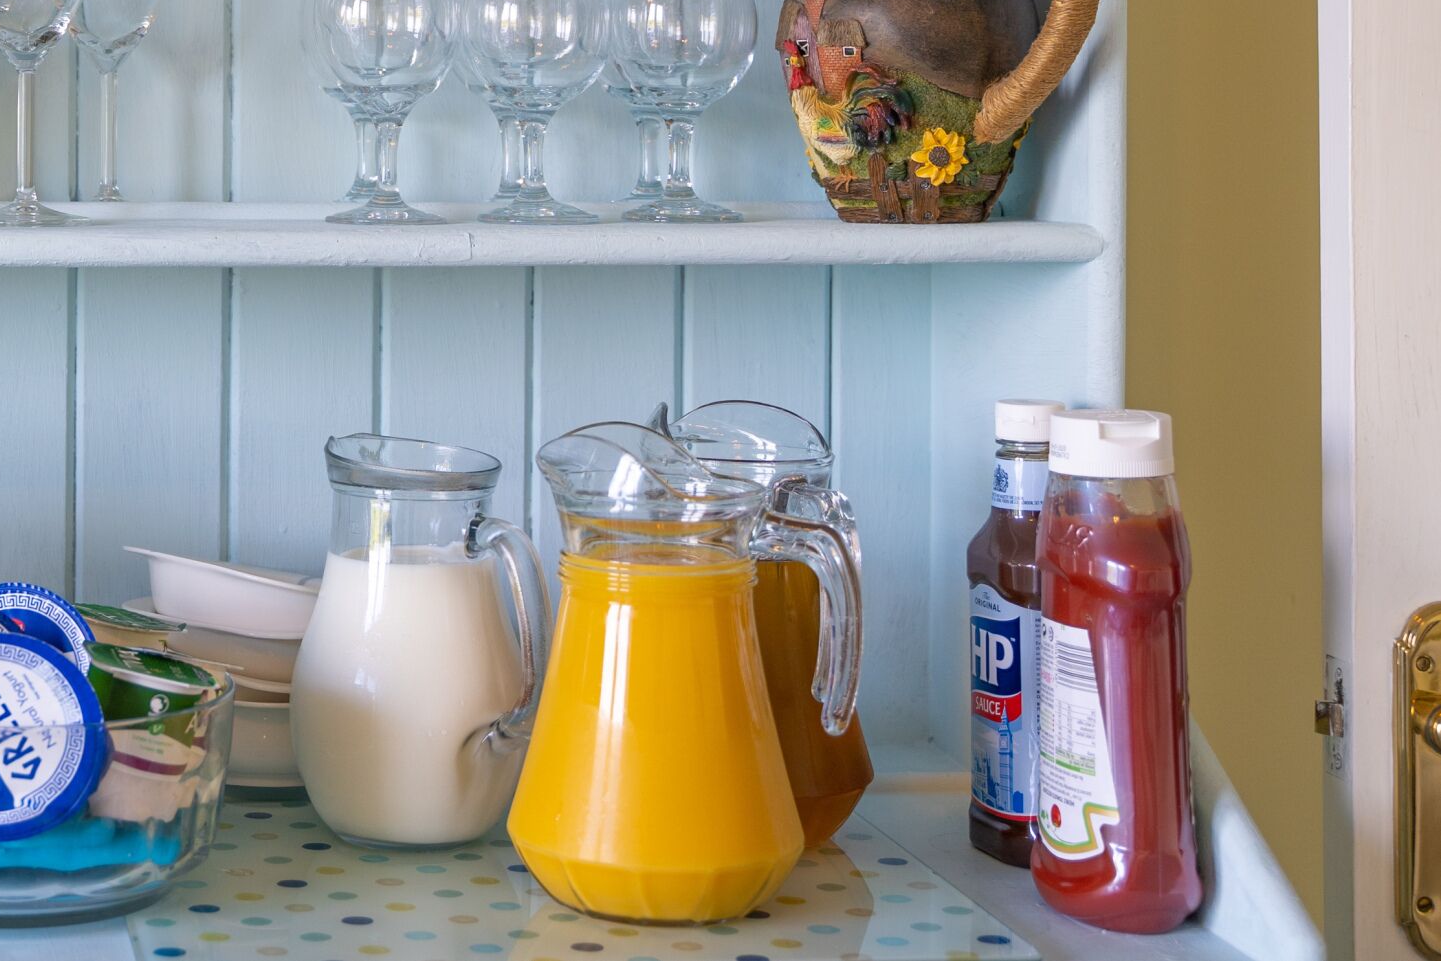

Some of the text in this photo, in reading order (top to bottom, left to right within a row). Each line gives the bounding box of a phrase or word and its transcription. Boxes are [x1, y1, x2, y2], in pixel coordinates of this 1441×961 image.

[974, 596, 1001, 613] ORIGINAL
[971, 623, 1015, 687] HP
[2, 670, 28, 707] Yogurt
[975, 696, 1001, 716] SAUCE
[22, 706, 57, 750] Naural
